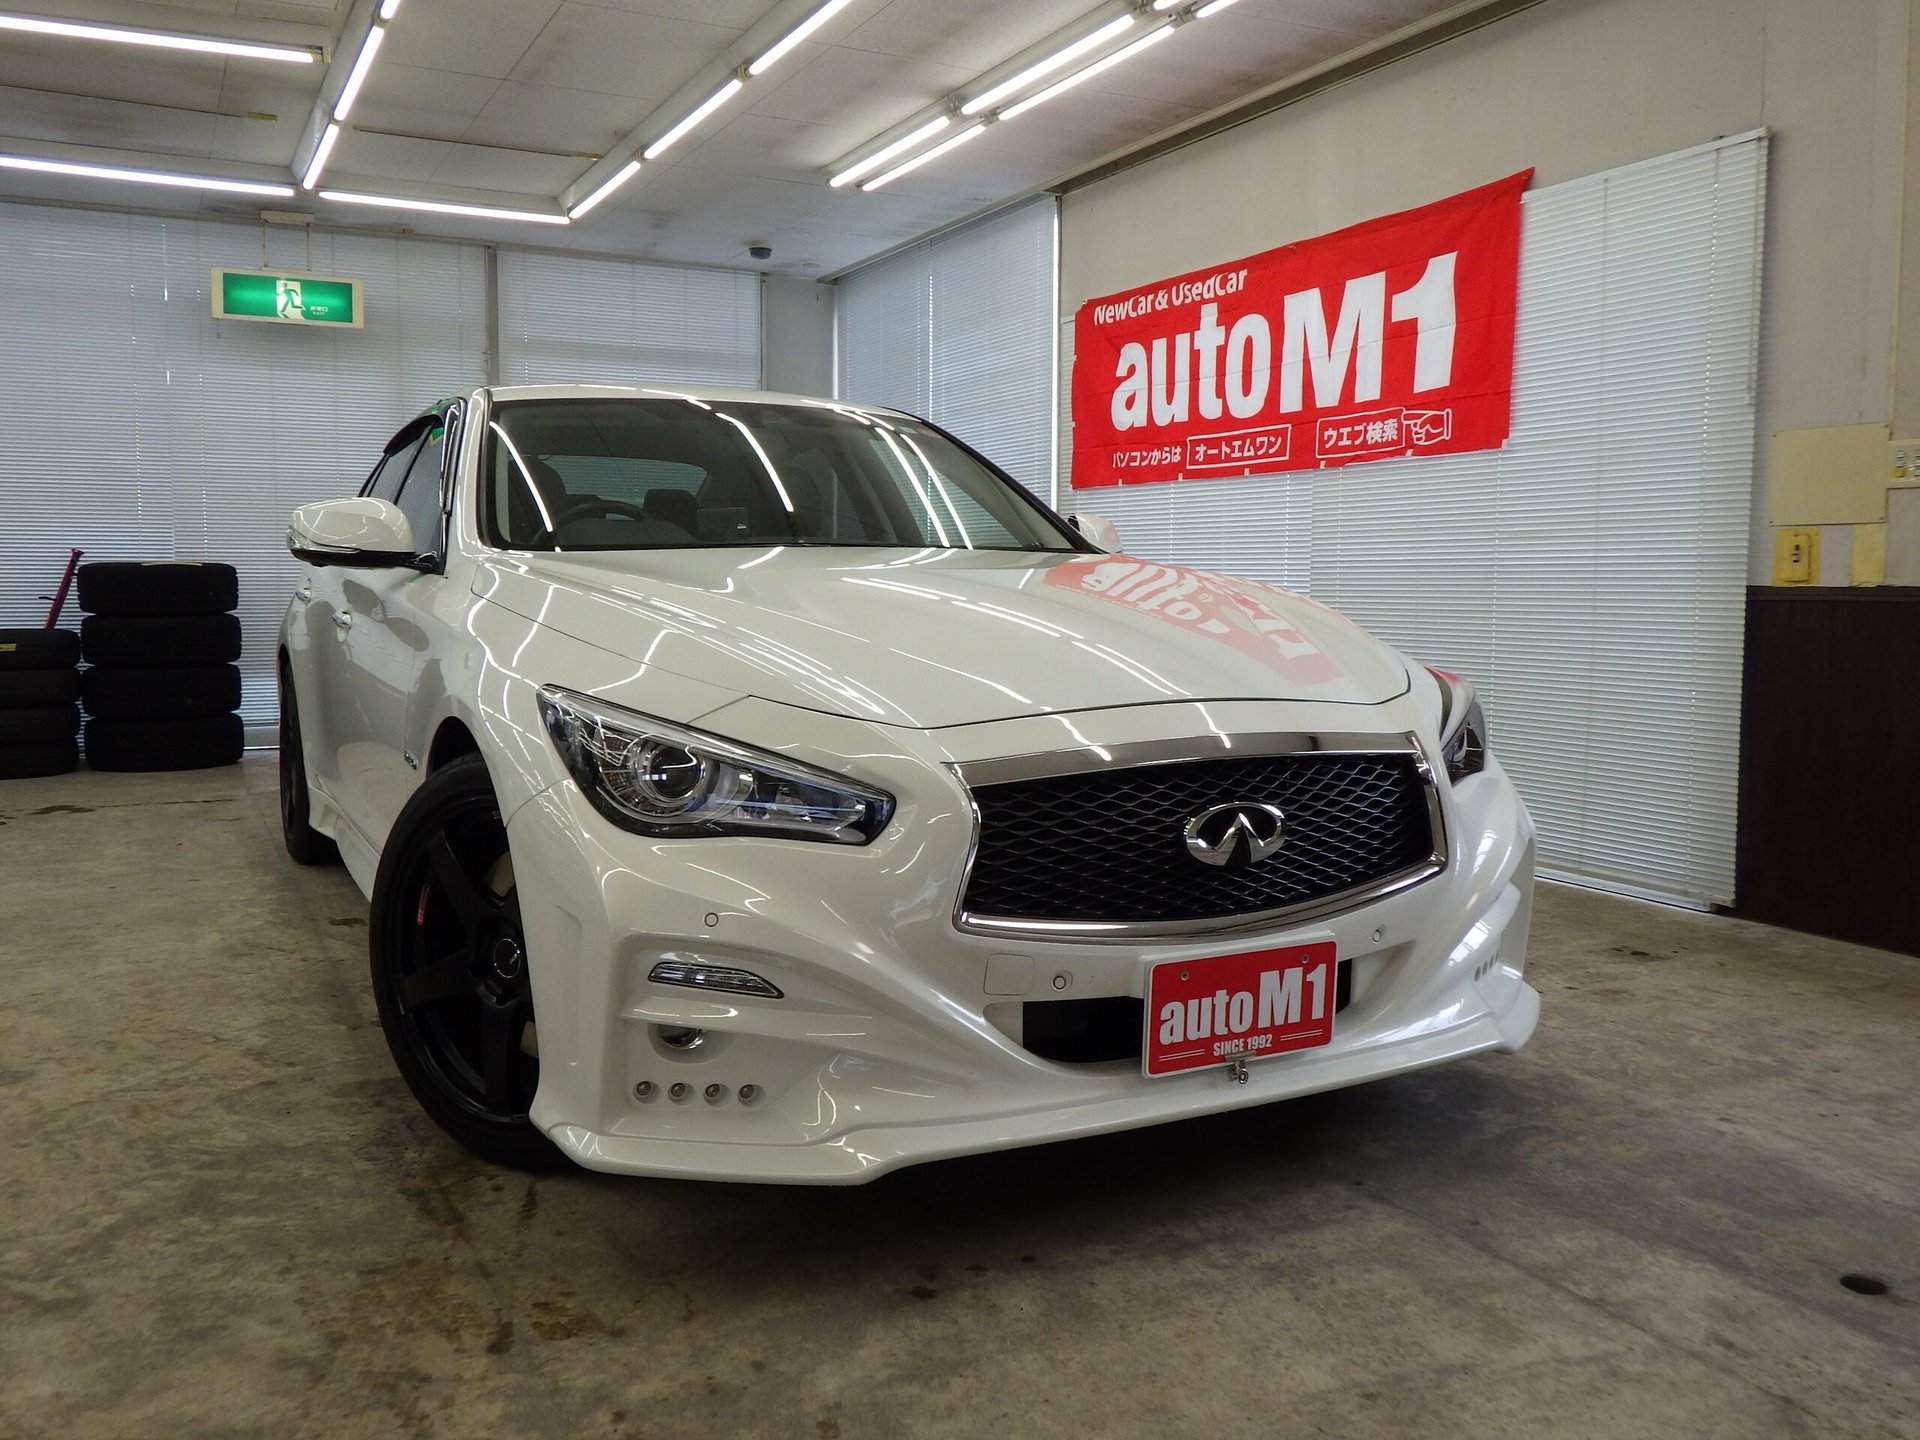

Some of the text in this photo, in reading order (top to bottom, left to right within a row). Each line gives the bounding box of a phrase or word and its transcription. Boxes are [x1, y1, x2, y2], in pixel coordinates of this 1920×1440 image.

[1324, 418, 1398, 449] ウエブ検索
[1112, 445, 1182, 468] パソコンからは
[1194, 436, 1282, 462] オートエムワン
[1213, 1033, 1273, 1056] SINCE 1992
